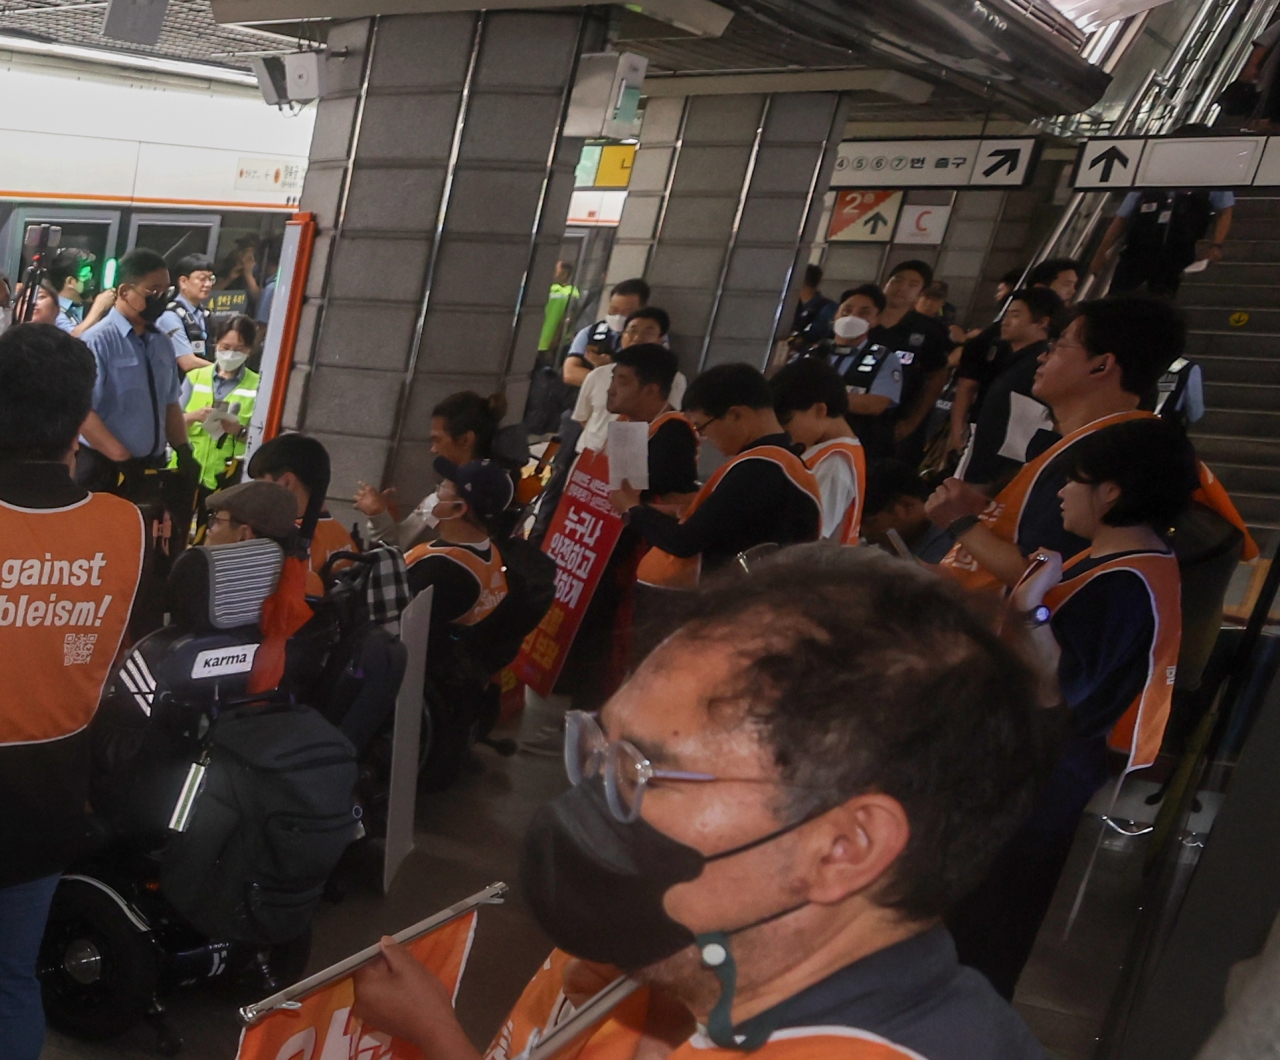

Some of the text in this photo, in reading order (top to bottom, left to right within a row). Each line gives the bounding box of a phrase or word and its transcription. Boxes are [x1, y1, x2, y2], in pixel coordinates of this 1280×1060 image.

[934, 157, 967, 169] 출구
[564, 505, 605, 547] 누구나
[547, 532, 597, 580] 안전하고
